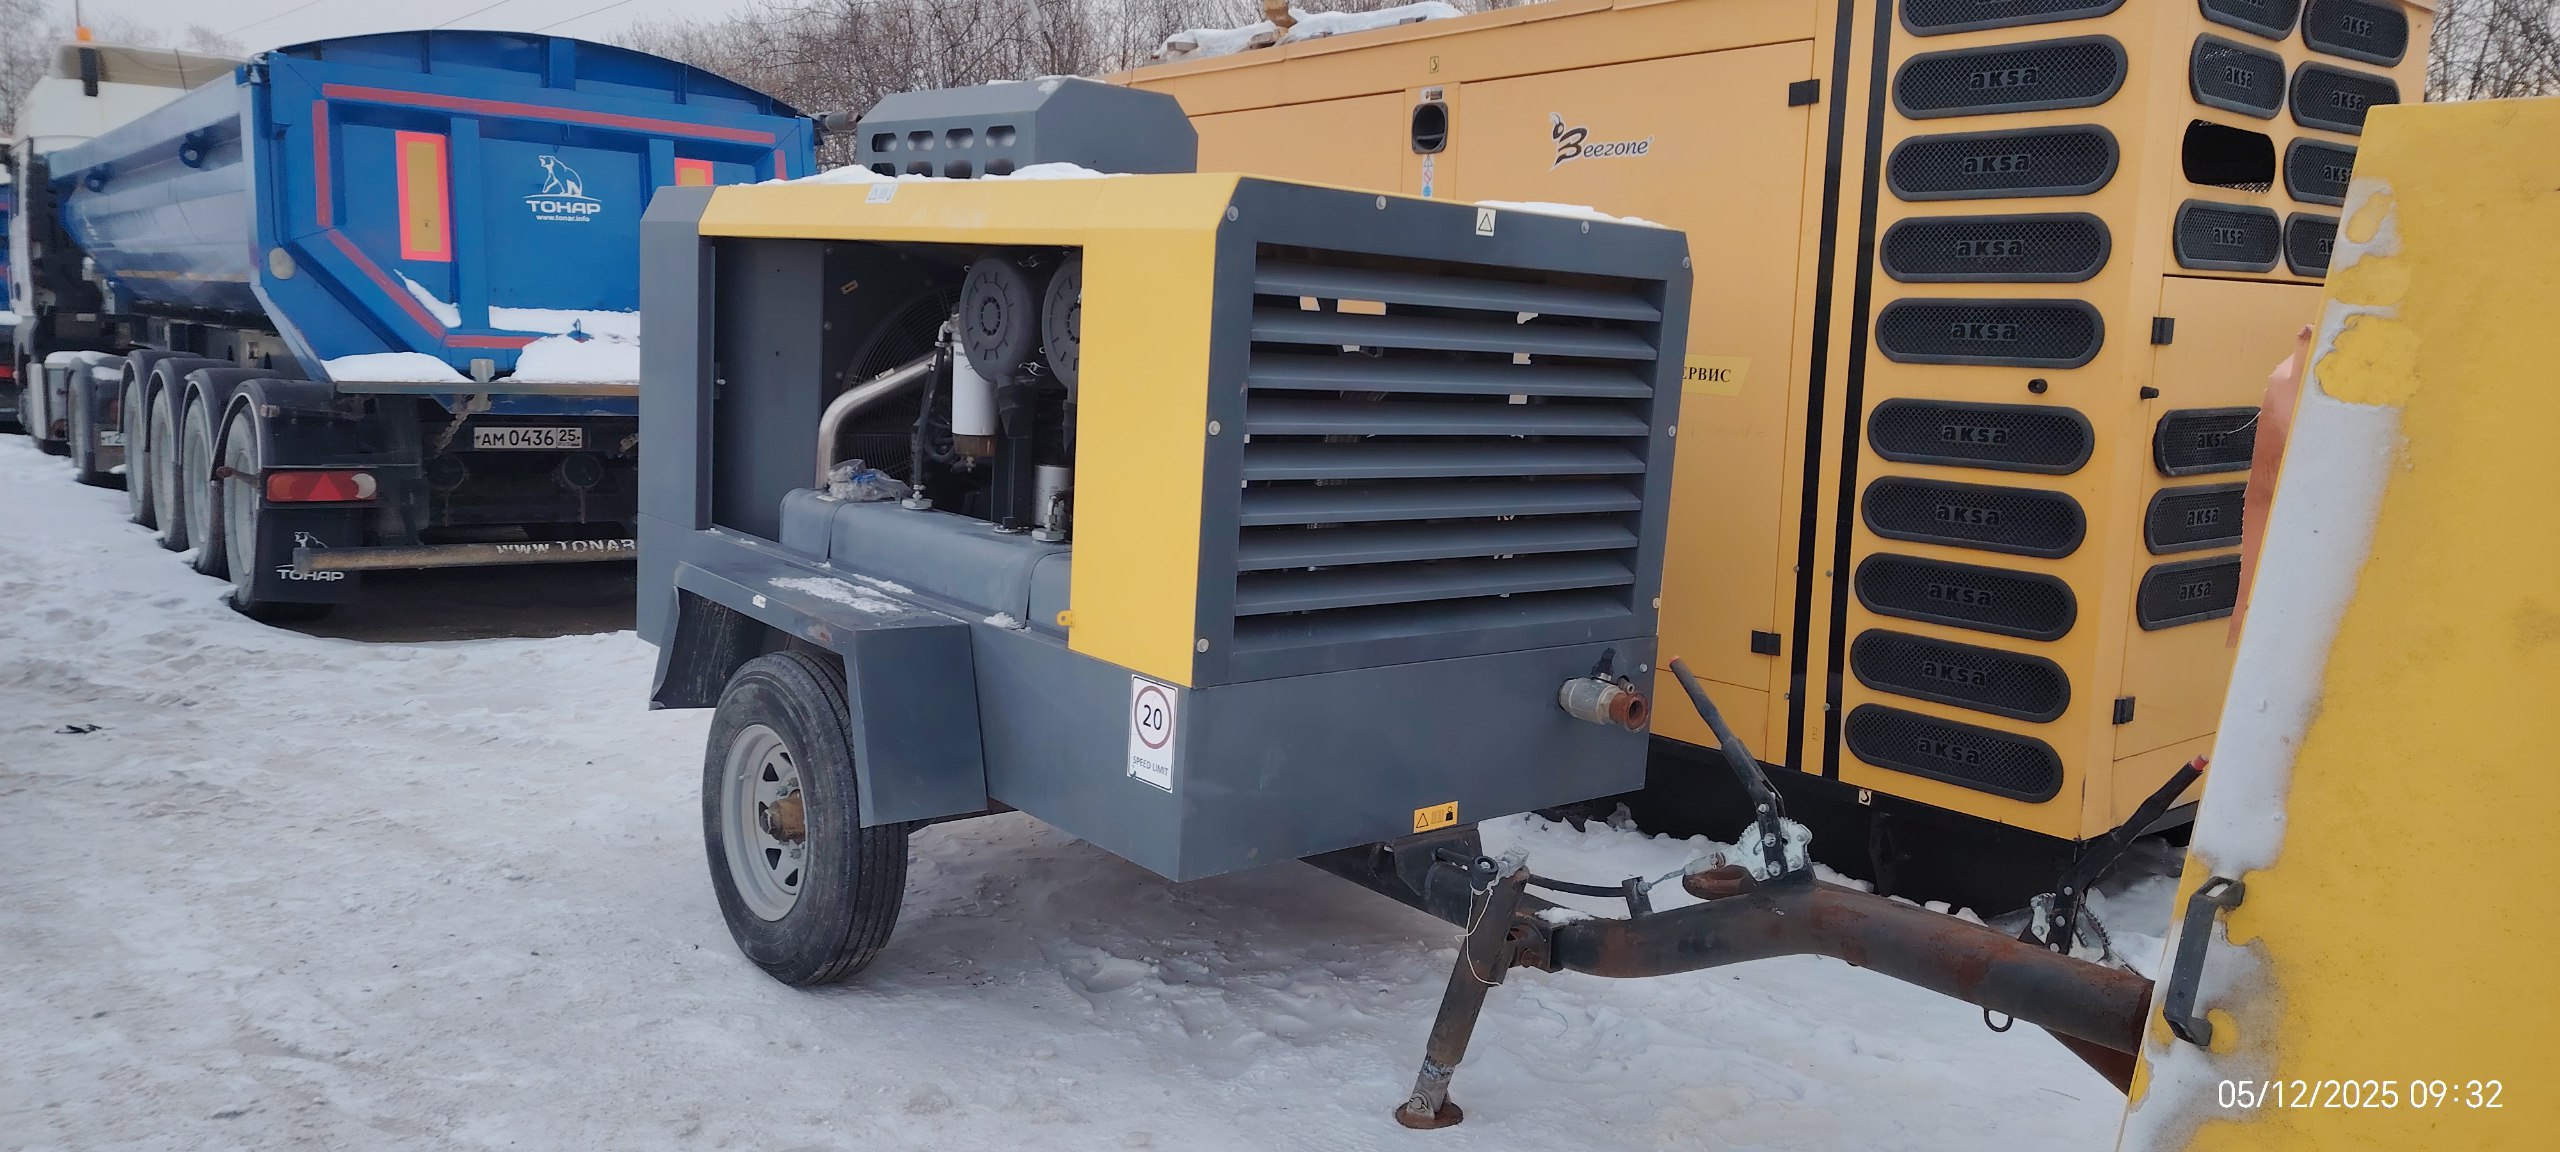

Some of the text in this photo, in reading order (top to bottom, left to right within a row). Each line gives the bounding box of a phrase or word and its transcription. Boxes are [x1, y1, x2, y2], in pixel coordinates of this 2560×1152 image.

[1970, 67, 2039, 89] aksa
[1554, 127, 1648, 166] Beezone
[1964, 154, 2031, 174] aksa
[526, 200, 601, 215] ТОНАР
[536, 214, 591, 222] www.tonar.info
[2213, 227, 2245, 245] aksa
[1957, 240, 2024, 257] aksa
[1951, 323, 2018, 340] aksa
[509, 430, 554, 446] 0436
[559, 429, 576, 441] 25
[1942, 425, 2008, 444] aksa
[1935, 504, 2001, 526] aksa
[2187, 507, 2219, 526] aksa
[1928, 584, 1992, 606] aksa
[2179, 581, 2212, 600] aksa
[1922, 660, 1987, 687] aksa
[1142, 704, 1163, 731] 20
[1917, 738, 1981, 765] aksa
[1132, 755, 1169, 776] SPEED LIMIT
